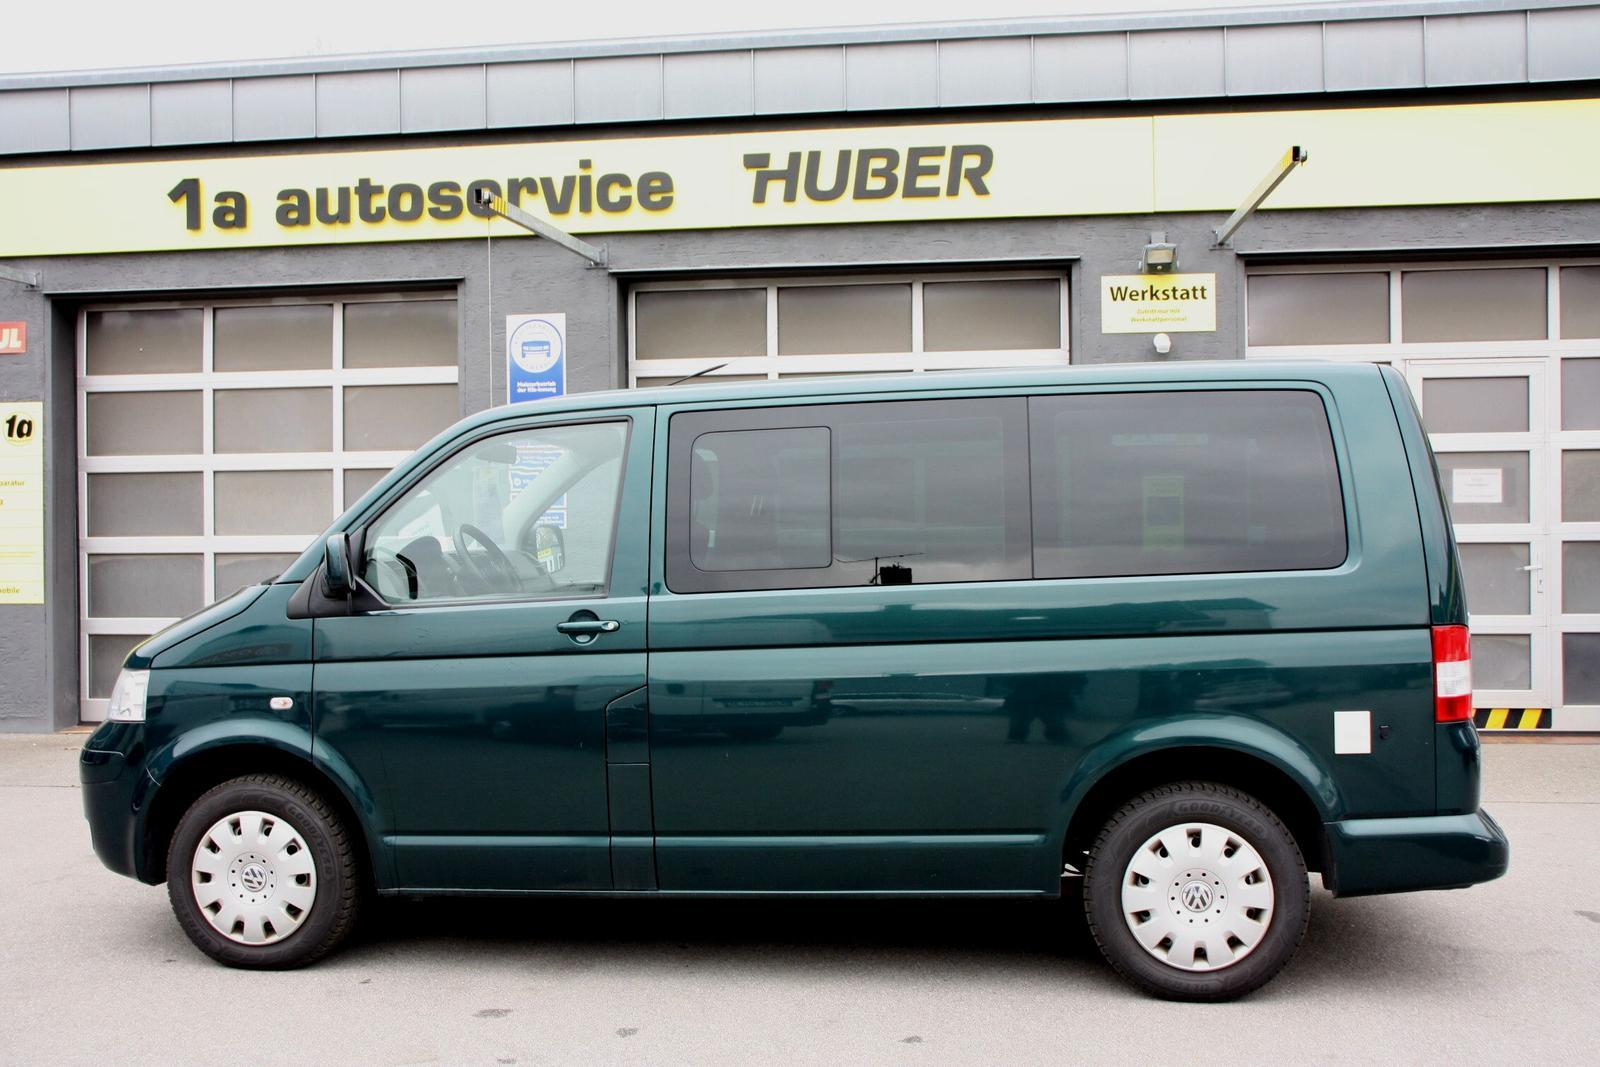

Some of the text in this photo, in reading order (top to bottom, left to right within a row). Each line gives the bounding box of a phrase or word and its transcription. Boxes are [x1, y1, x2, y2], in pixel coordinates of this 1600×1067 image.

[167, 144, 994, 230] 1a autoservice HUBER
[1110, 285, 1207, 301] Werkstatt
[6, 415, 33, 438] 1a
